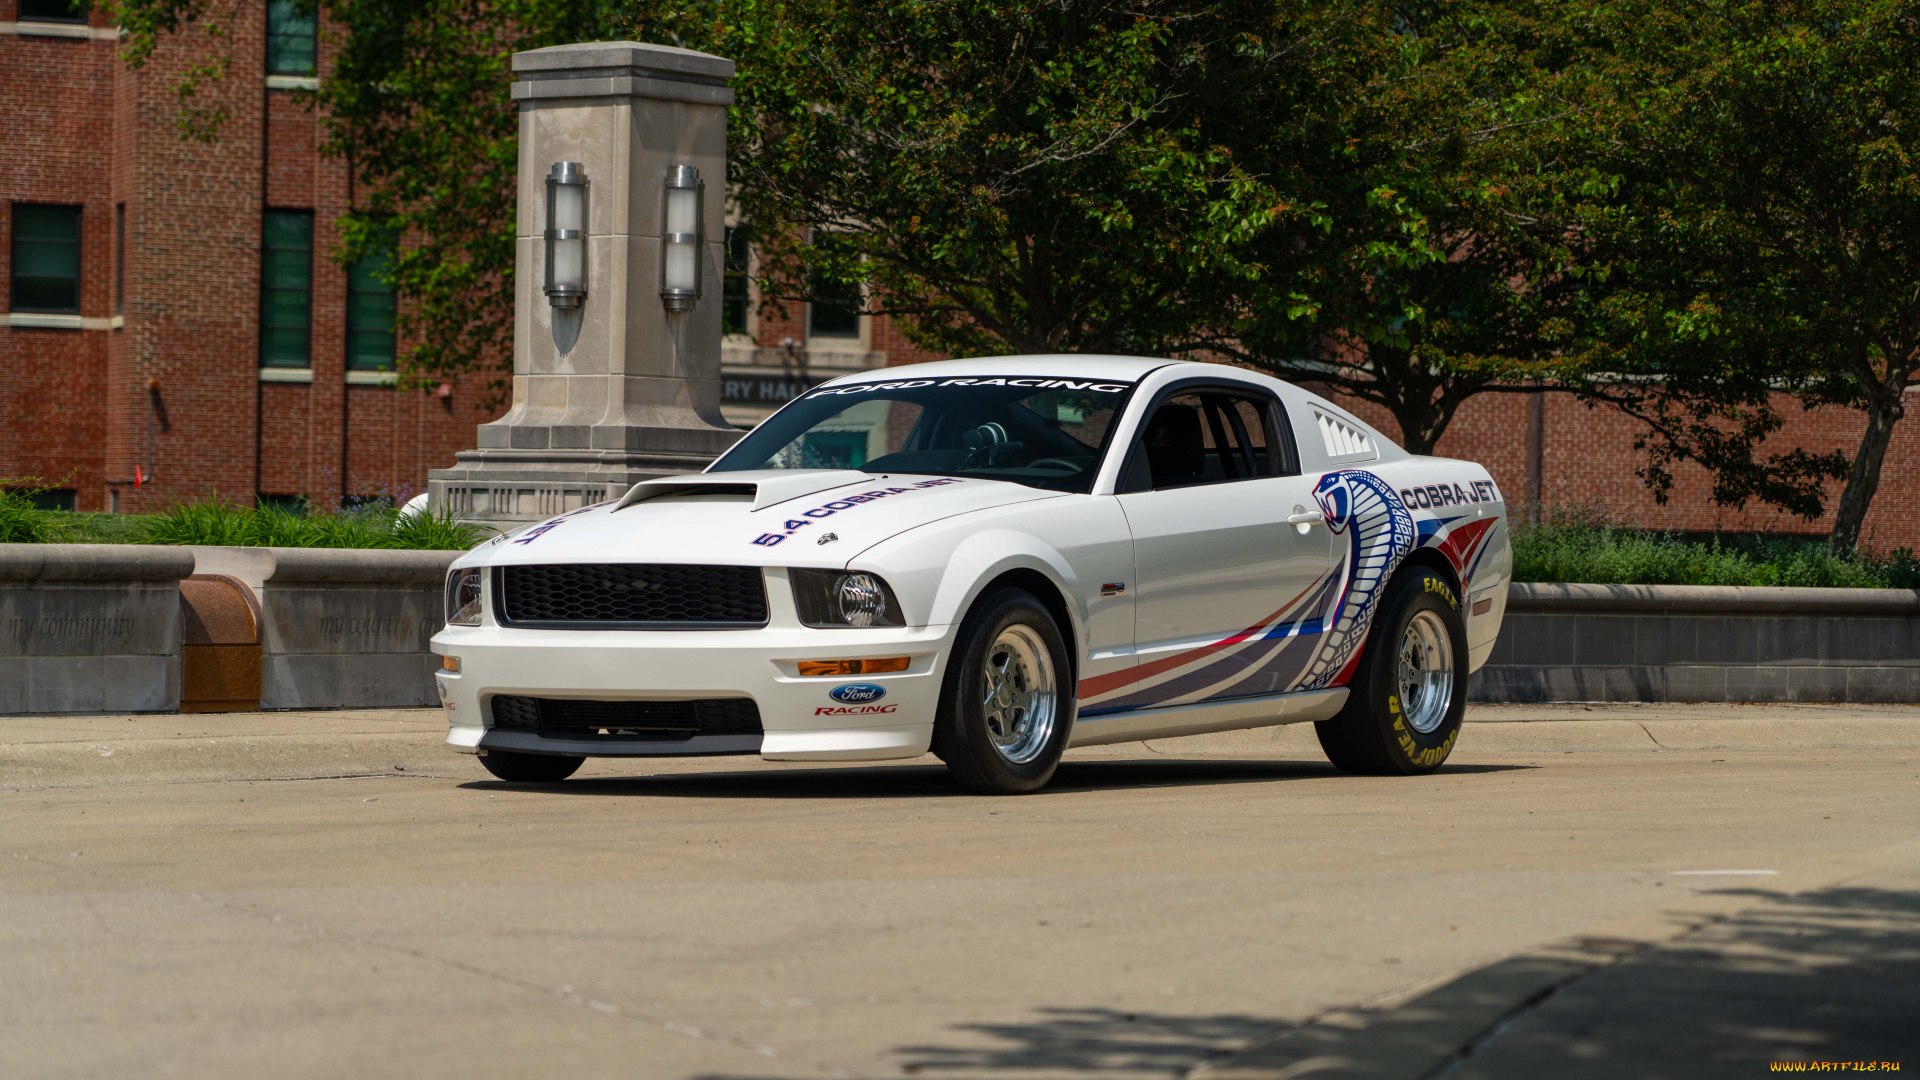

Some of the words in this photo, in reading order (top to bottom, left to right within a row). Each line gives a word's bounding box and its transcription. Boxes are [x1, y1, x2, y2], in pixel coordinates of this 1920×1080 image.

[720, 381, 752, 399] RY
[805, 380, 936, 400] FORD
[939, 378, 1130, 393] RACING
[1400, 482, 1469, 511] COBRA
[1467, 480, 1498, 504] JET
[750, 518, 814, 547] 5.4
[801, 486, 918, 519] COBRA
[911, 477, 967, 489] JET
[1423, 577, 1458, 610] EAGLE
[8, 617, 35, 645] my
[40, 608, 135, 645] community
[320, 617, 344, 643] my
[841, 685, 876, 700] Ford
[814, 703, 899, 716] RACING
[1388, 694, 1457, 766] GOODYEAR
